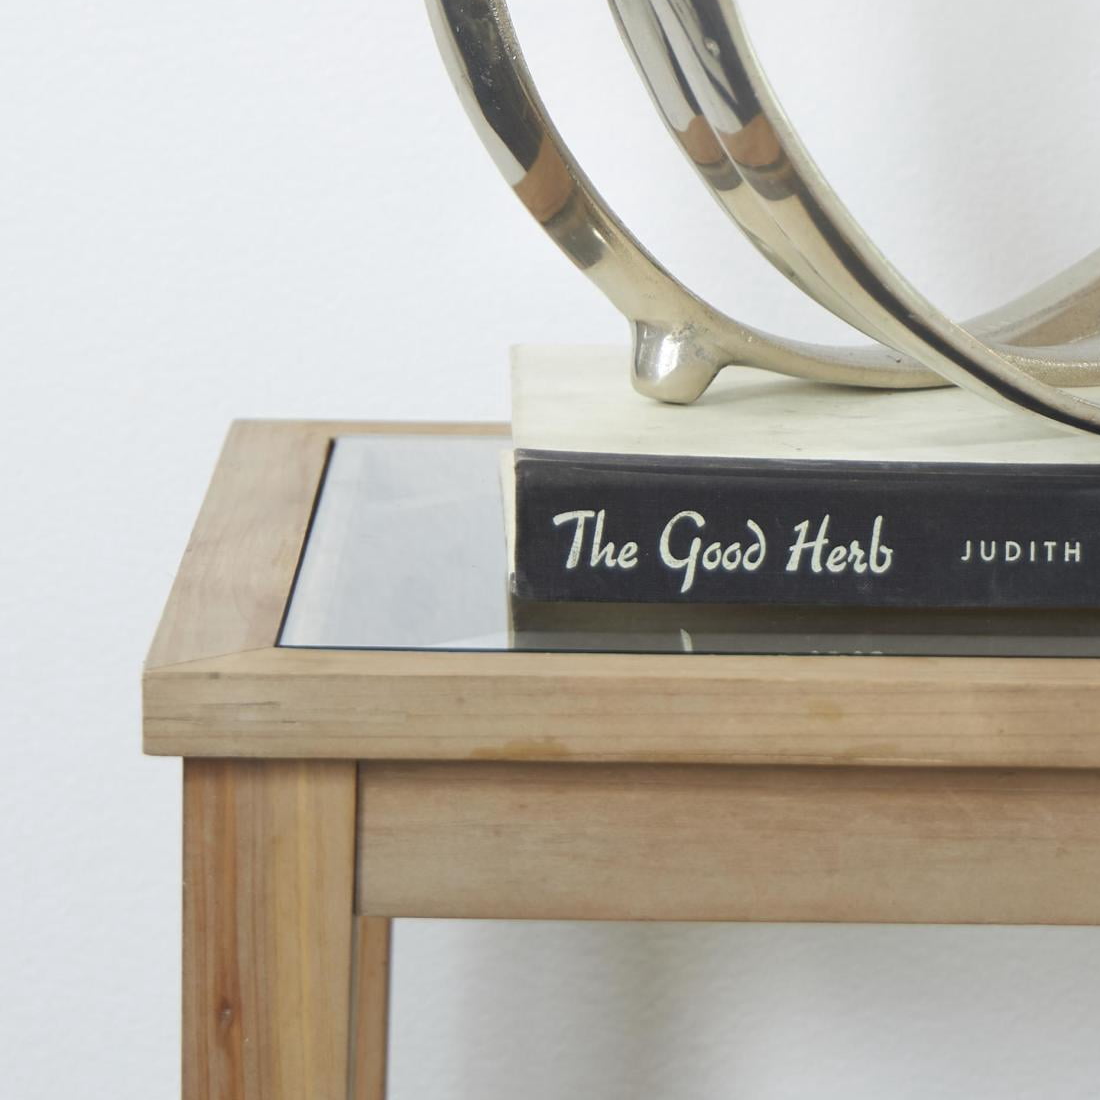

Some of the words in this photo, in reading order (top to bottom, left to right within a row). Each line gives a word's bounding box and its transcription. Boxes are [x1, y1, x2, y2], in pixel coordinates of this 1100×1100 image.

[552, 508, 639, 570] The
[658, 509, 768, 594] Good
[784, 513, 895, 574] Herb
[959, 539, 1083, 563] JUDITH
